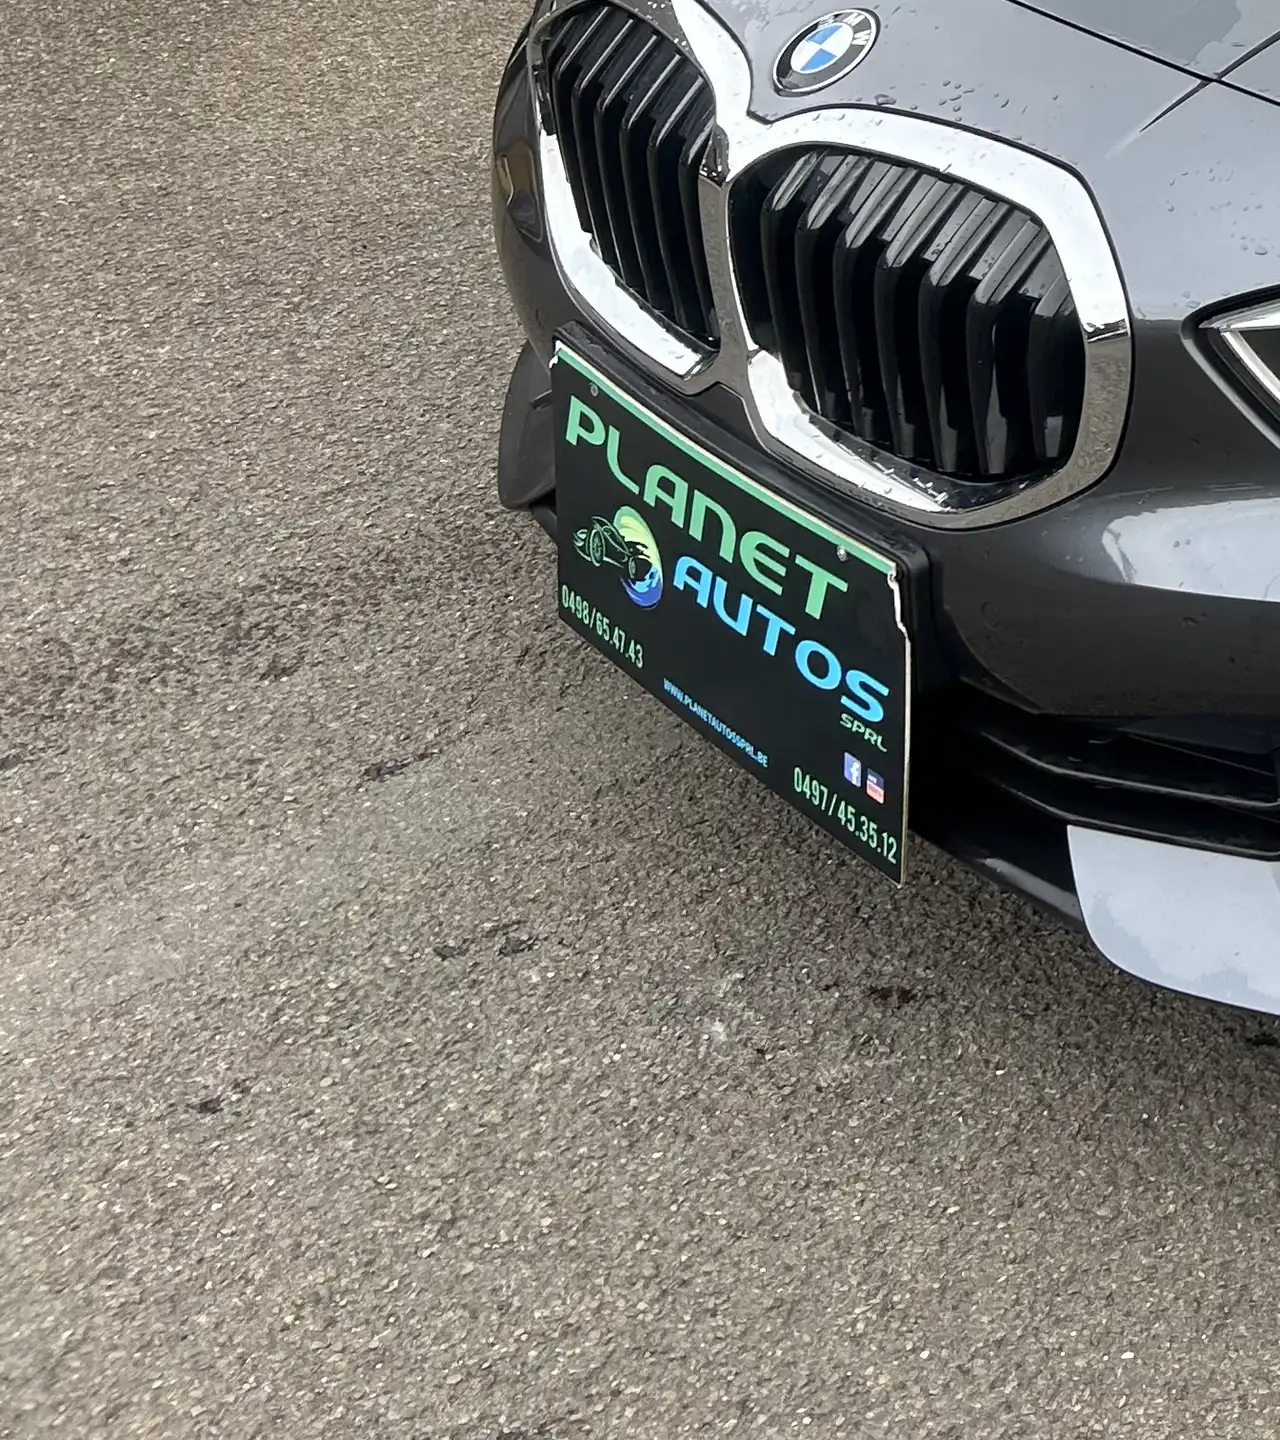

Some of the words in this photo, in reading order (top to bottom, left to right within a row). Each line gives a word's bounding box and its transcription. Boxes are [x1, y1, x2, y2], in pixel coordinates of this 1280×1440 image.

[565, 394, 849, 620] PLANET
[561, 583, 645, 670] 0498/65.47.43
[672, 555, 890, 723] AUTOS
[663, 677, 769, 769] WWW.PLANETAUTOSSPRL.BE
[839, 712, 888, 753] SPRL
[792, 766, 898, 865] 0497/45.35.12
